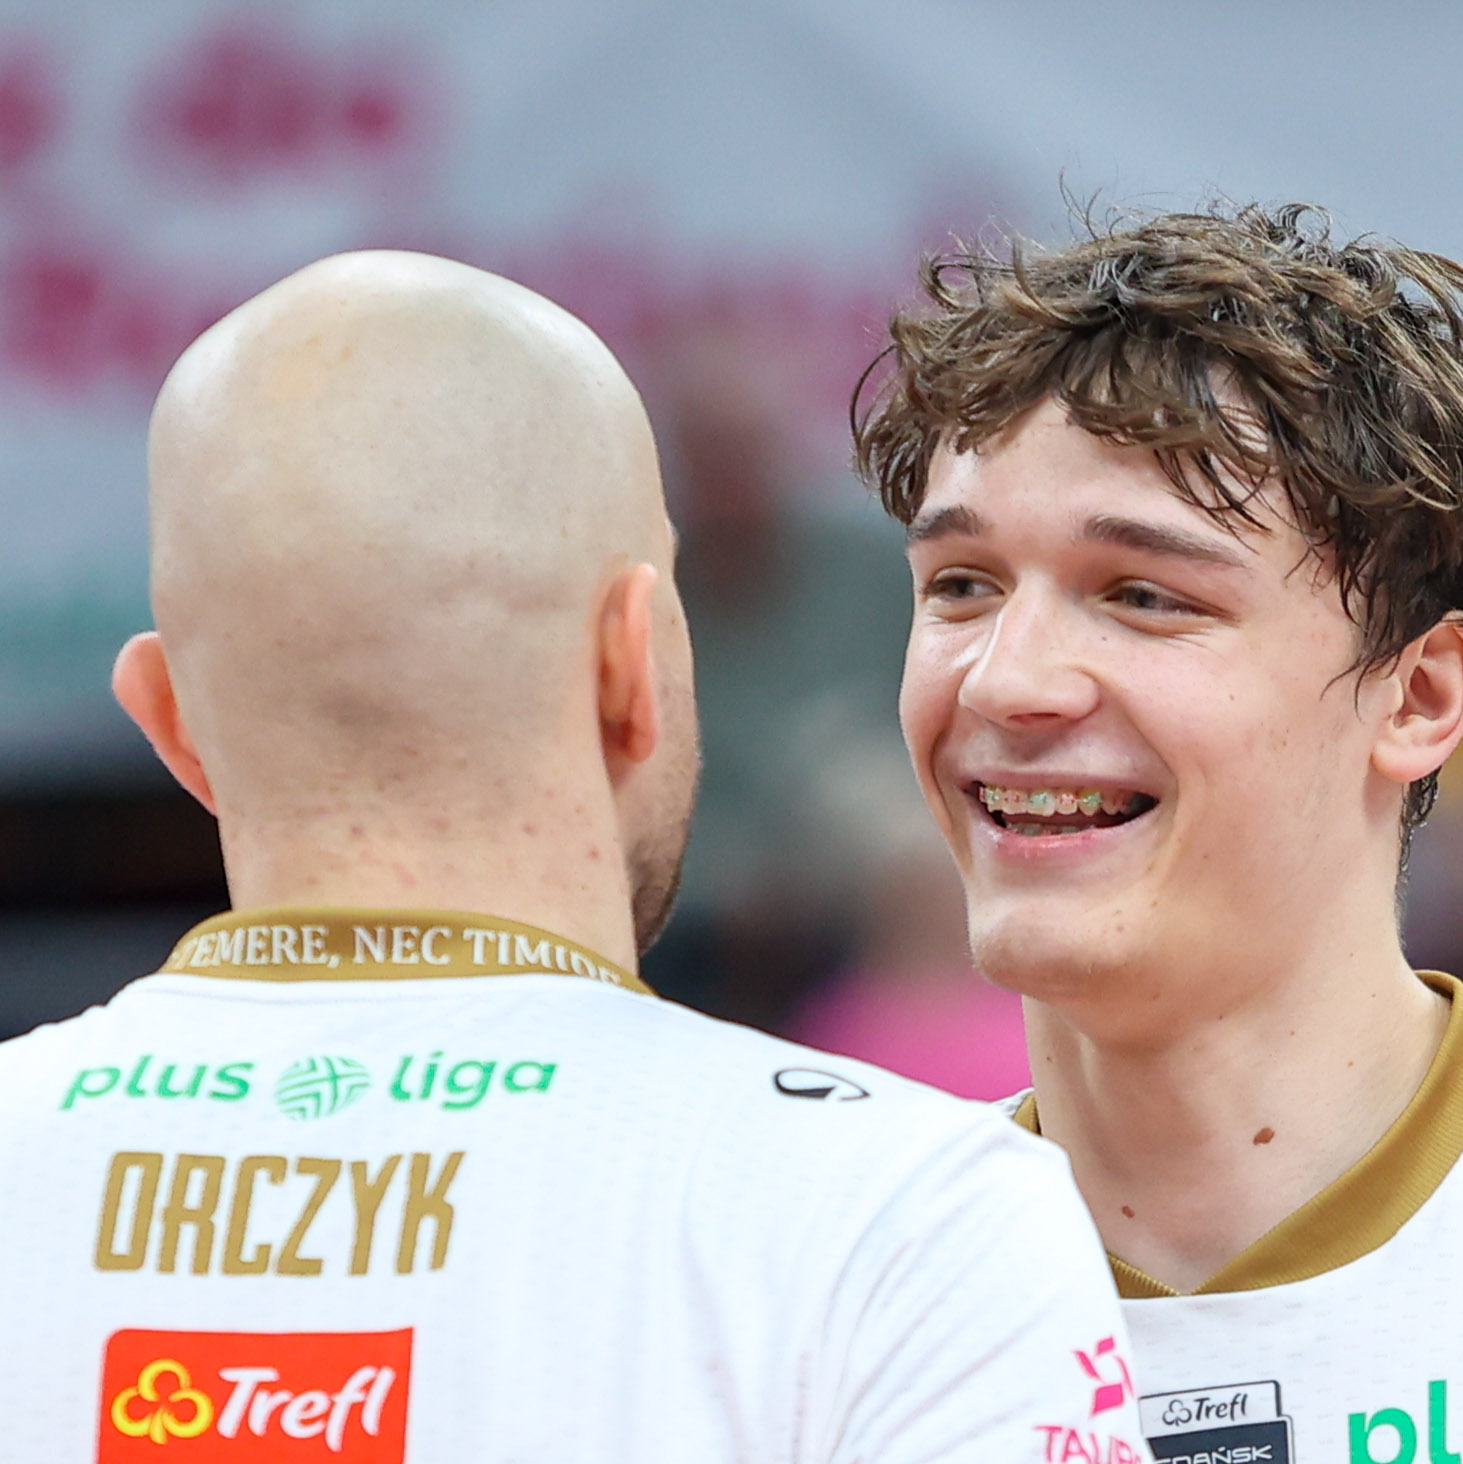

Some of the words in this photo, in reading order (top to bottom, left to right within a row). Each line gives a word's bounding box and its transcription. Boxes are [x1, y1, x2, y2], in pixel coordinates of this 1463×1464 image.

[352, 926, 450, 966] NEC
[59, 1054, 255, 1111] plus
[388, 1051, 557, 1111] liga
[94, 1149, 467, 1277] ORCZYK
[217, 1365, 397, 1453] Trefl
[1193, 1393, 1249, 1422] Trefl
